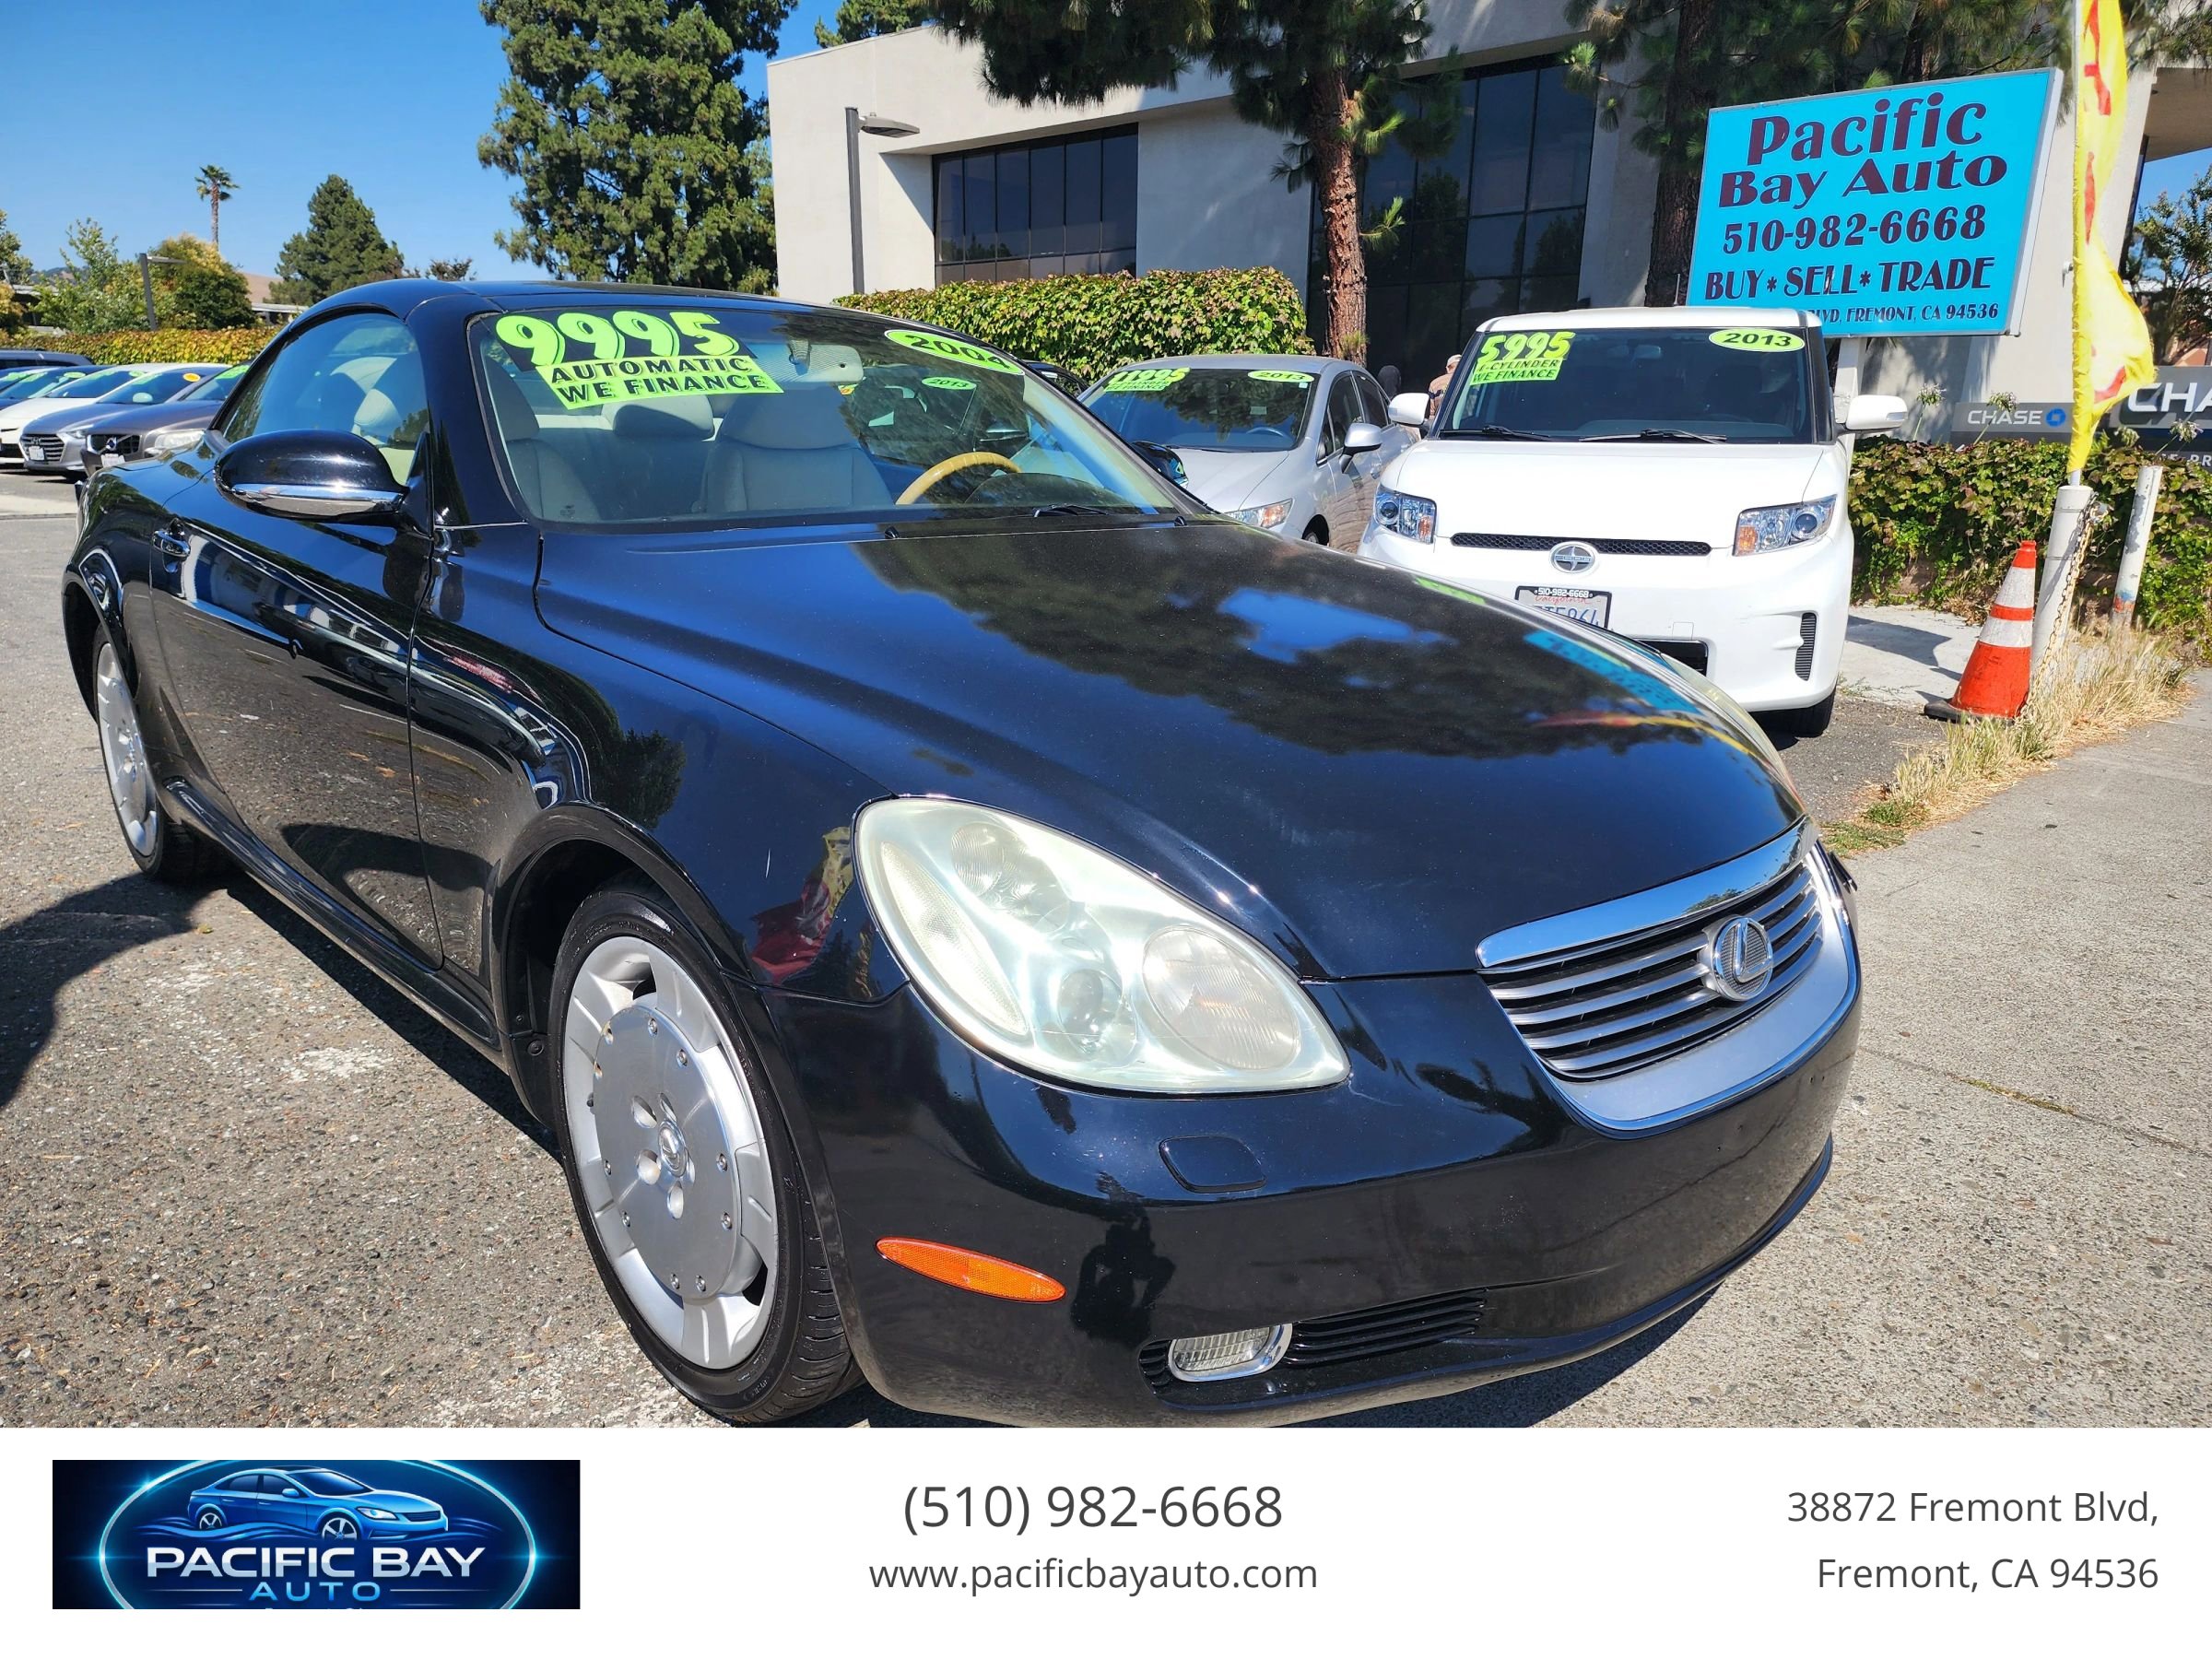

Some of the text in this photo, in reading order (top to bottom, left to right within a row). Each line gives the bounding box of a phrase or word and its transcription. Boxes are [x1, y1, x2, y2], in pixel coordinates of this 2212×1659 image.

[1747, 92, 1986, 165] Pacific
[1719, 149, 2007, 209] Bay Auto
[1723, 205, 1985, 253] 510-982-6668
[1705, 257, 1994, 300] BUY SELL TRADE
[1846, 306, 1916, 323] FREMONT,
[1921, 304, 1941, 320] CA
[1946, 303, 1998, 320] 94536
[496, 311, 739, 367] 9995
[1479, 332, 1575, 365] 5995
[1723, 333, 1792, 347] 2013
[551, 358, 750, 384] AUTOMATIC
[1473, 369, 1557, 382] WE FINANCE
[556, 373, 767, 404] WE FINANCE
[1968, 409, 2043, 425] CHASE
[1538, 587, 1590, 598] 510-982-6668
